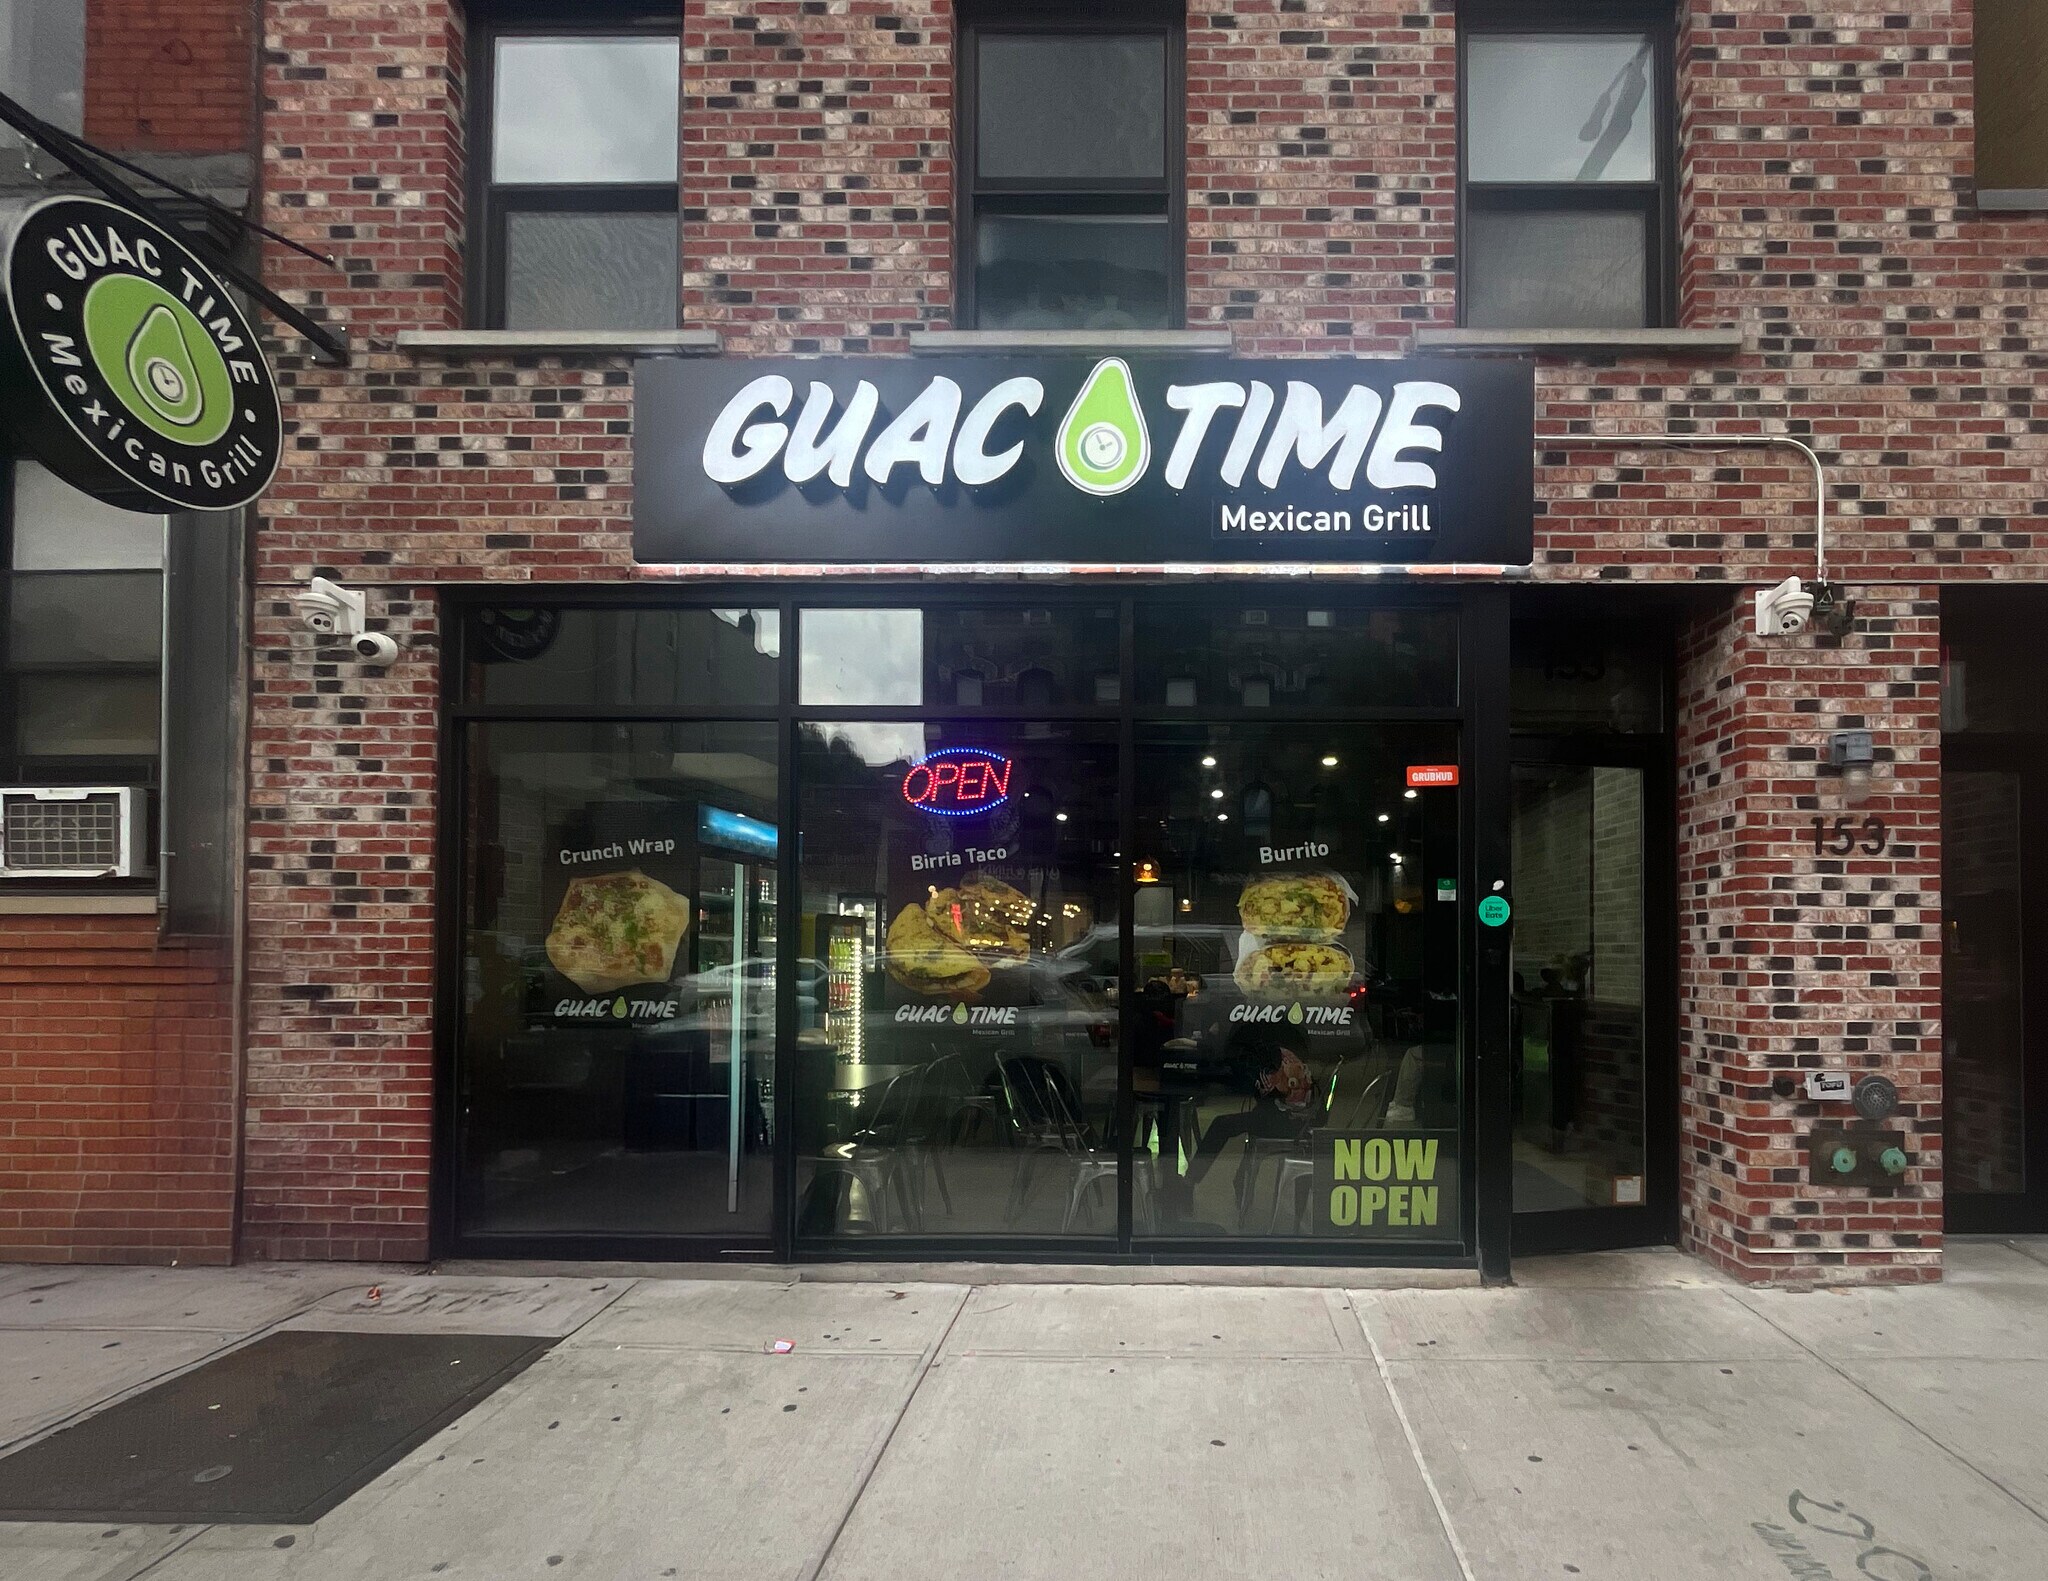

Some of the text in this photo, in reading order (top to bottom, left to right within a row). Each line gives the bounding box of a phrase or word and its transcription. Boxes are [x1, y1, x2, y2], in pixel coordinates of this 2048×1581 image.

[46, 224, 260, 385] GUAC TIME
[41, 332, 263, 489] Mexican Grill
[702, 374, 1461, 491] GUAC TIME
[1220, 503, 1432, 532] Mexican Grill
[902, 759, 1012, 804] OPEN
[1411, 771, 1454, 782] GRUBHUB
[1810, 816, 1886, 856] 153
[559, 838, 676, 865] Crunch Wrap
[911, 847, 1007, 871] Birria Taco
[1259, 841, 1329, 864] Burrito
[554, 998, 679, 1019] GUAC TIME
[894, 1003, 1019, 1025] GUAC TIME
[1229, 1004, 1355, 1025] GUAC TIME
[1333, 1138, 1439, 1182] NOW
[1329, 1185, 1439, 1227] OPEN
